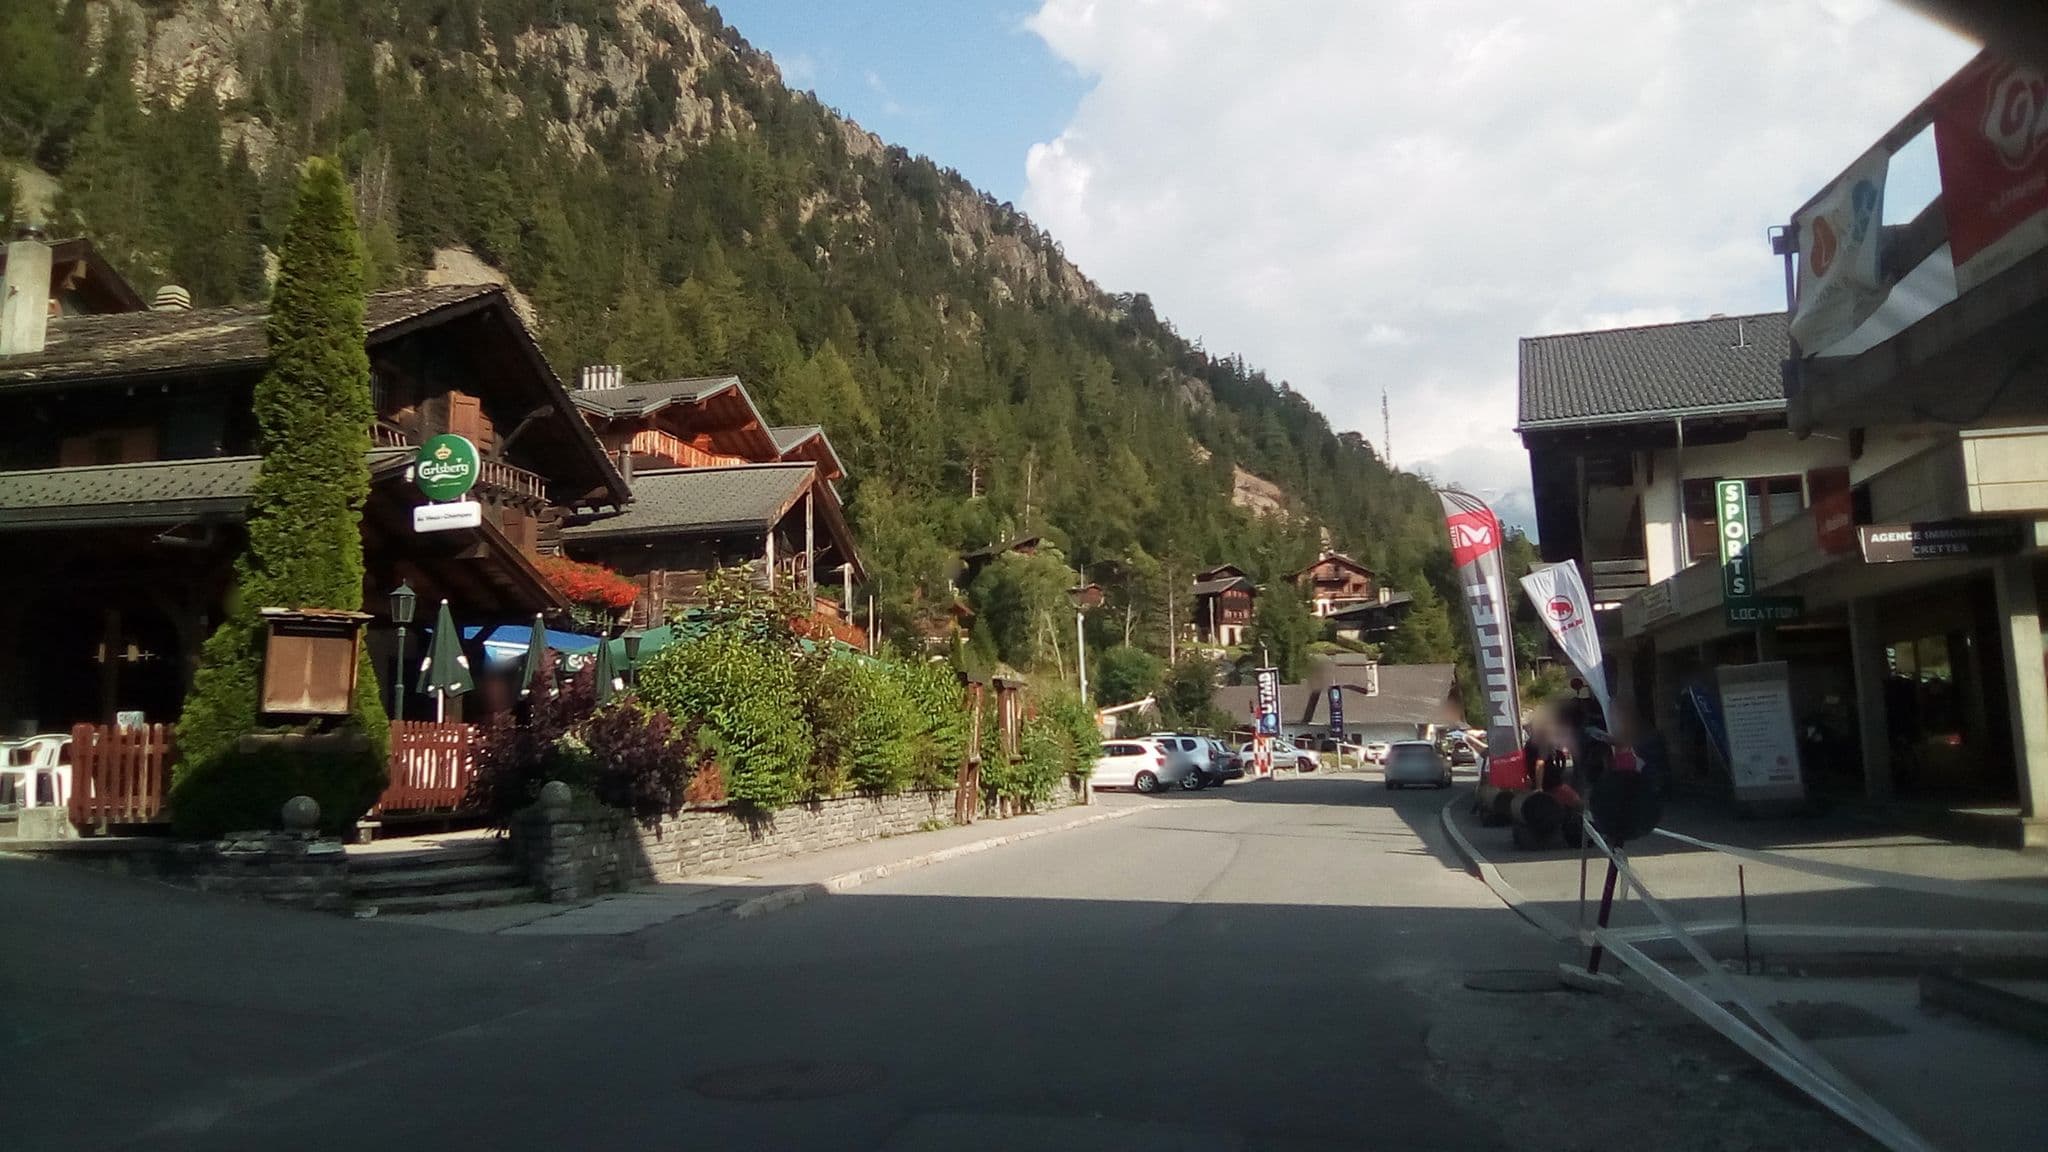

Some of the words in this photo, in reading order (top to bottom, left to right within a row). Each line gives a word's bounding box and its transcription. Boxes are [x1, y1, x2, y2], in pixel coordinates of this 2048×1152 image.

[418, 461, 469, 482] Carlsberg
[1725, 485, 1745, 593] SPORTS
[1871, 529, 1922, 543] AGENCE
[1730, 607, 1800, 620] LOCATION
[1259, 672, 1272, 714] UTMB
